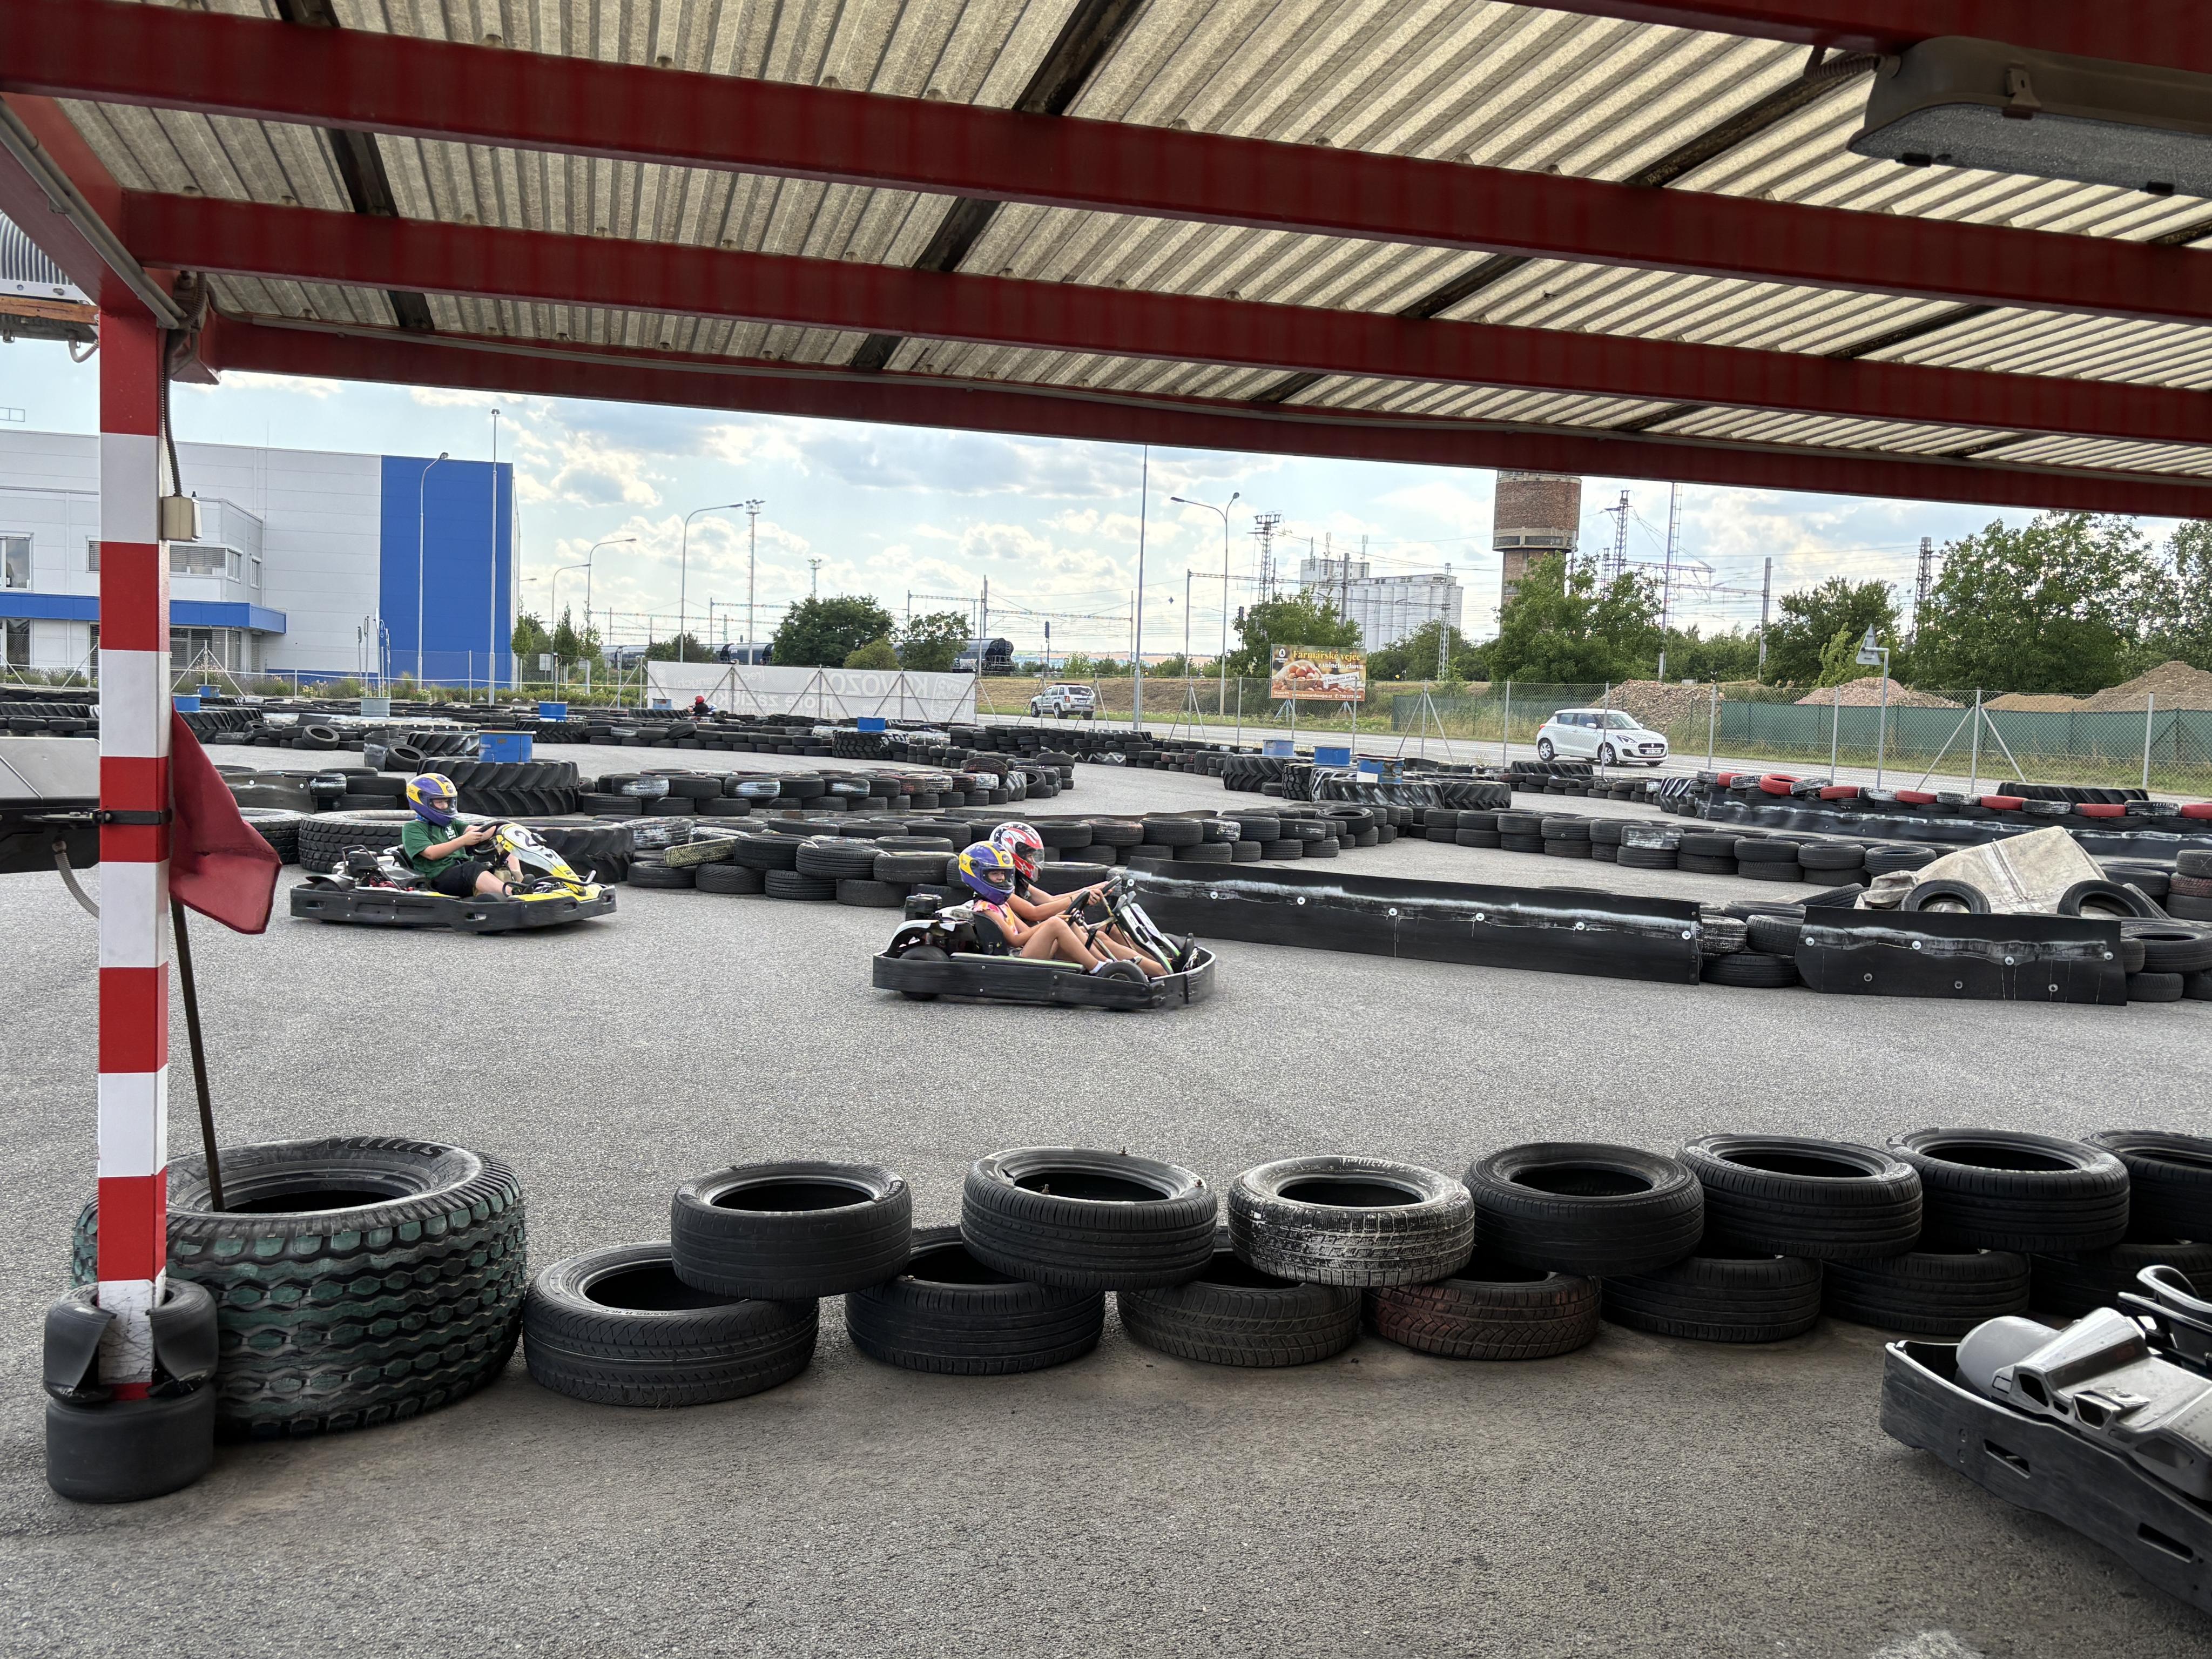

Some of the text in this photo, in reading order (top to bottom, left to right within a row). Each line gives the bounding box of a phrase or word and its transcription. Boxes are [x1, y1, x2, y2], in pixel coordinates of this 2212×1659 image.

[1293, 650, 1361, 662] Farmářské vejce
[514, 830, 538, 848] 2
